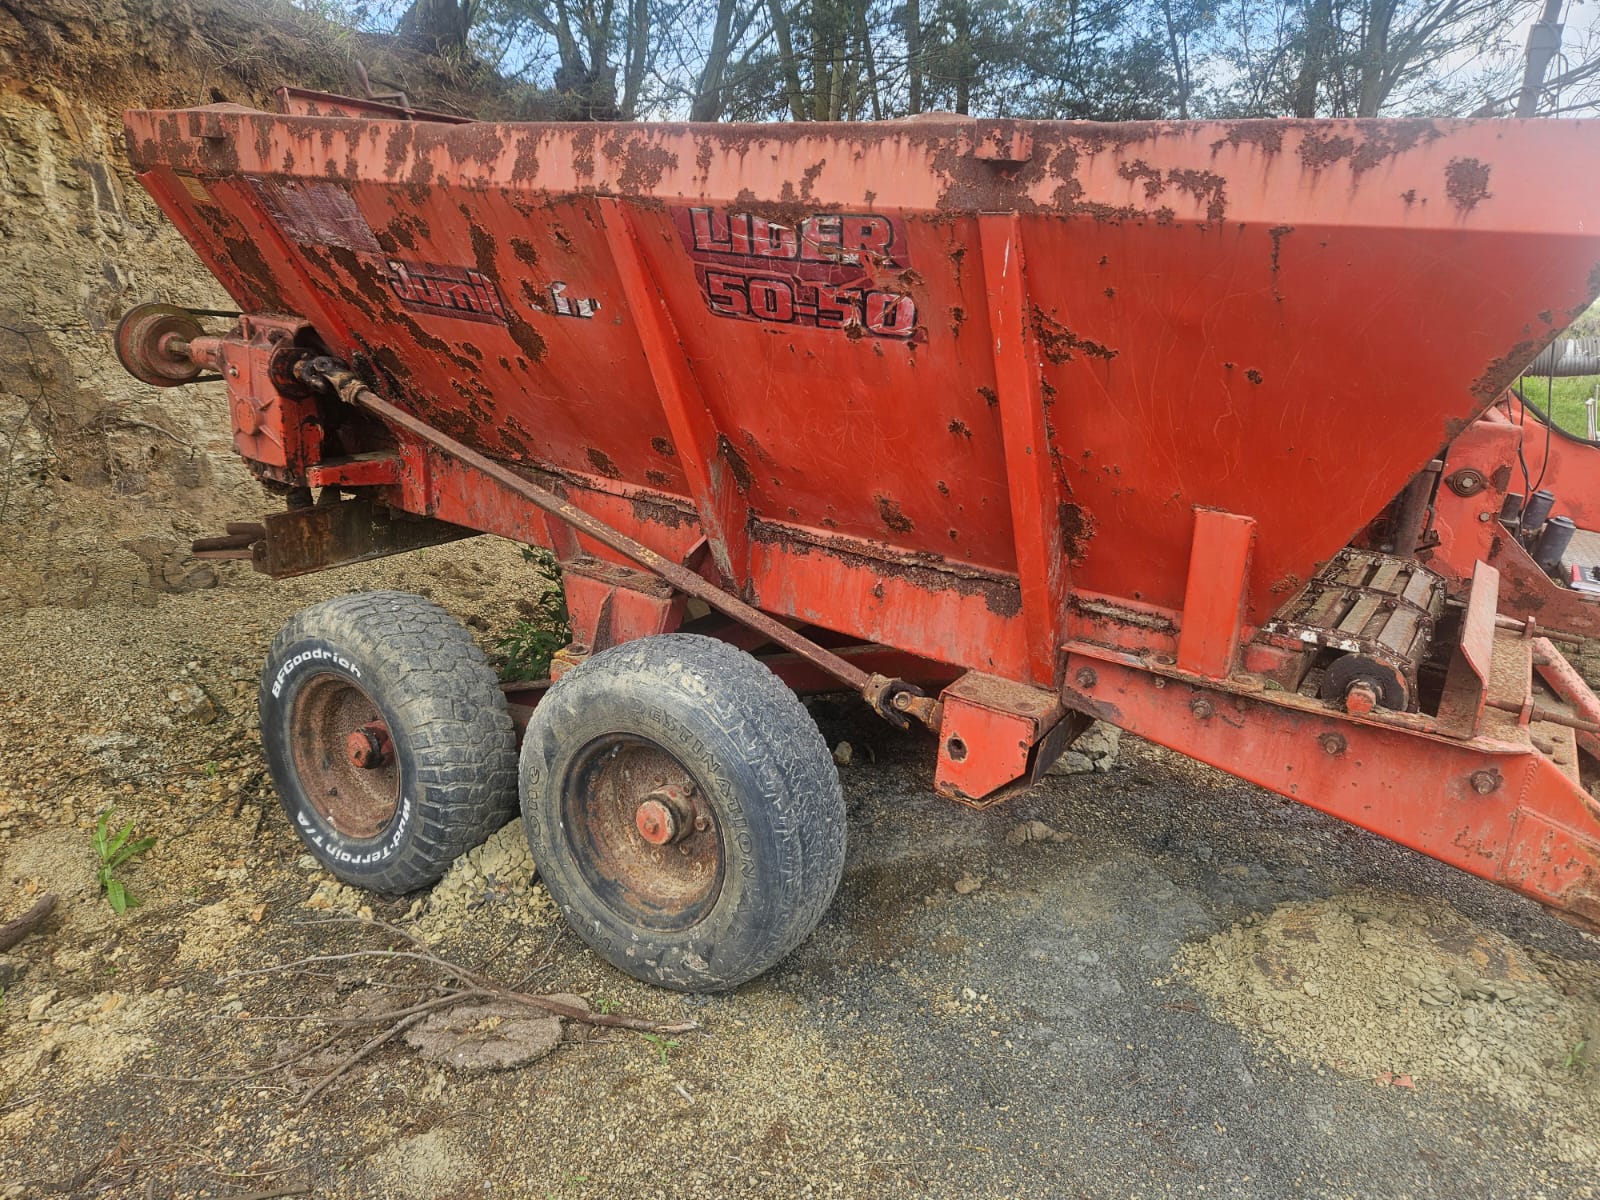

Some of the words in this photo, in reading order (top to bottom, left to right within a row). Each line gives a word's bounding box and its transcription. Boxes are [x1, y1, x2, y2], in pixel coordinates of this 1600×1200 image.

[688, 206, 905, 269] LIDER
[387, 259, 511, 327] Jumil
[705, 270, 920, 340] 50-50
[271, 648, 362, 699] BFGoodrich
[296, 810, 329, 849] T/A
